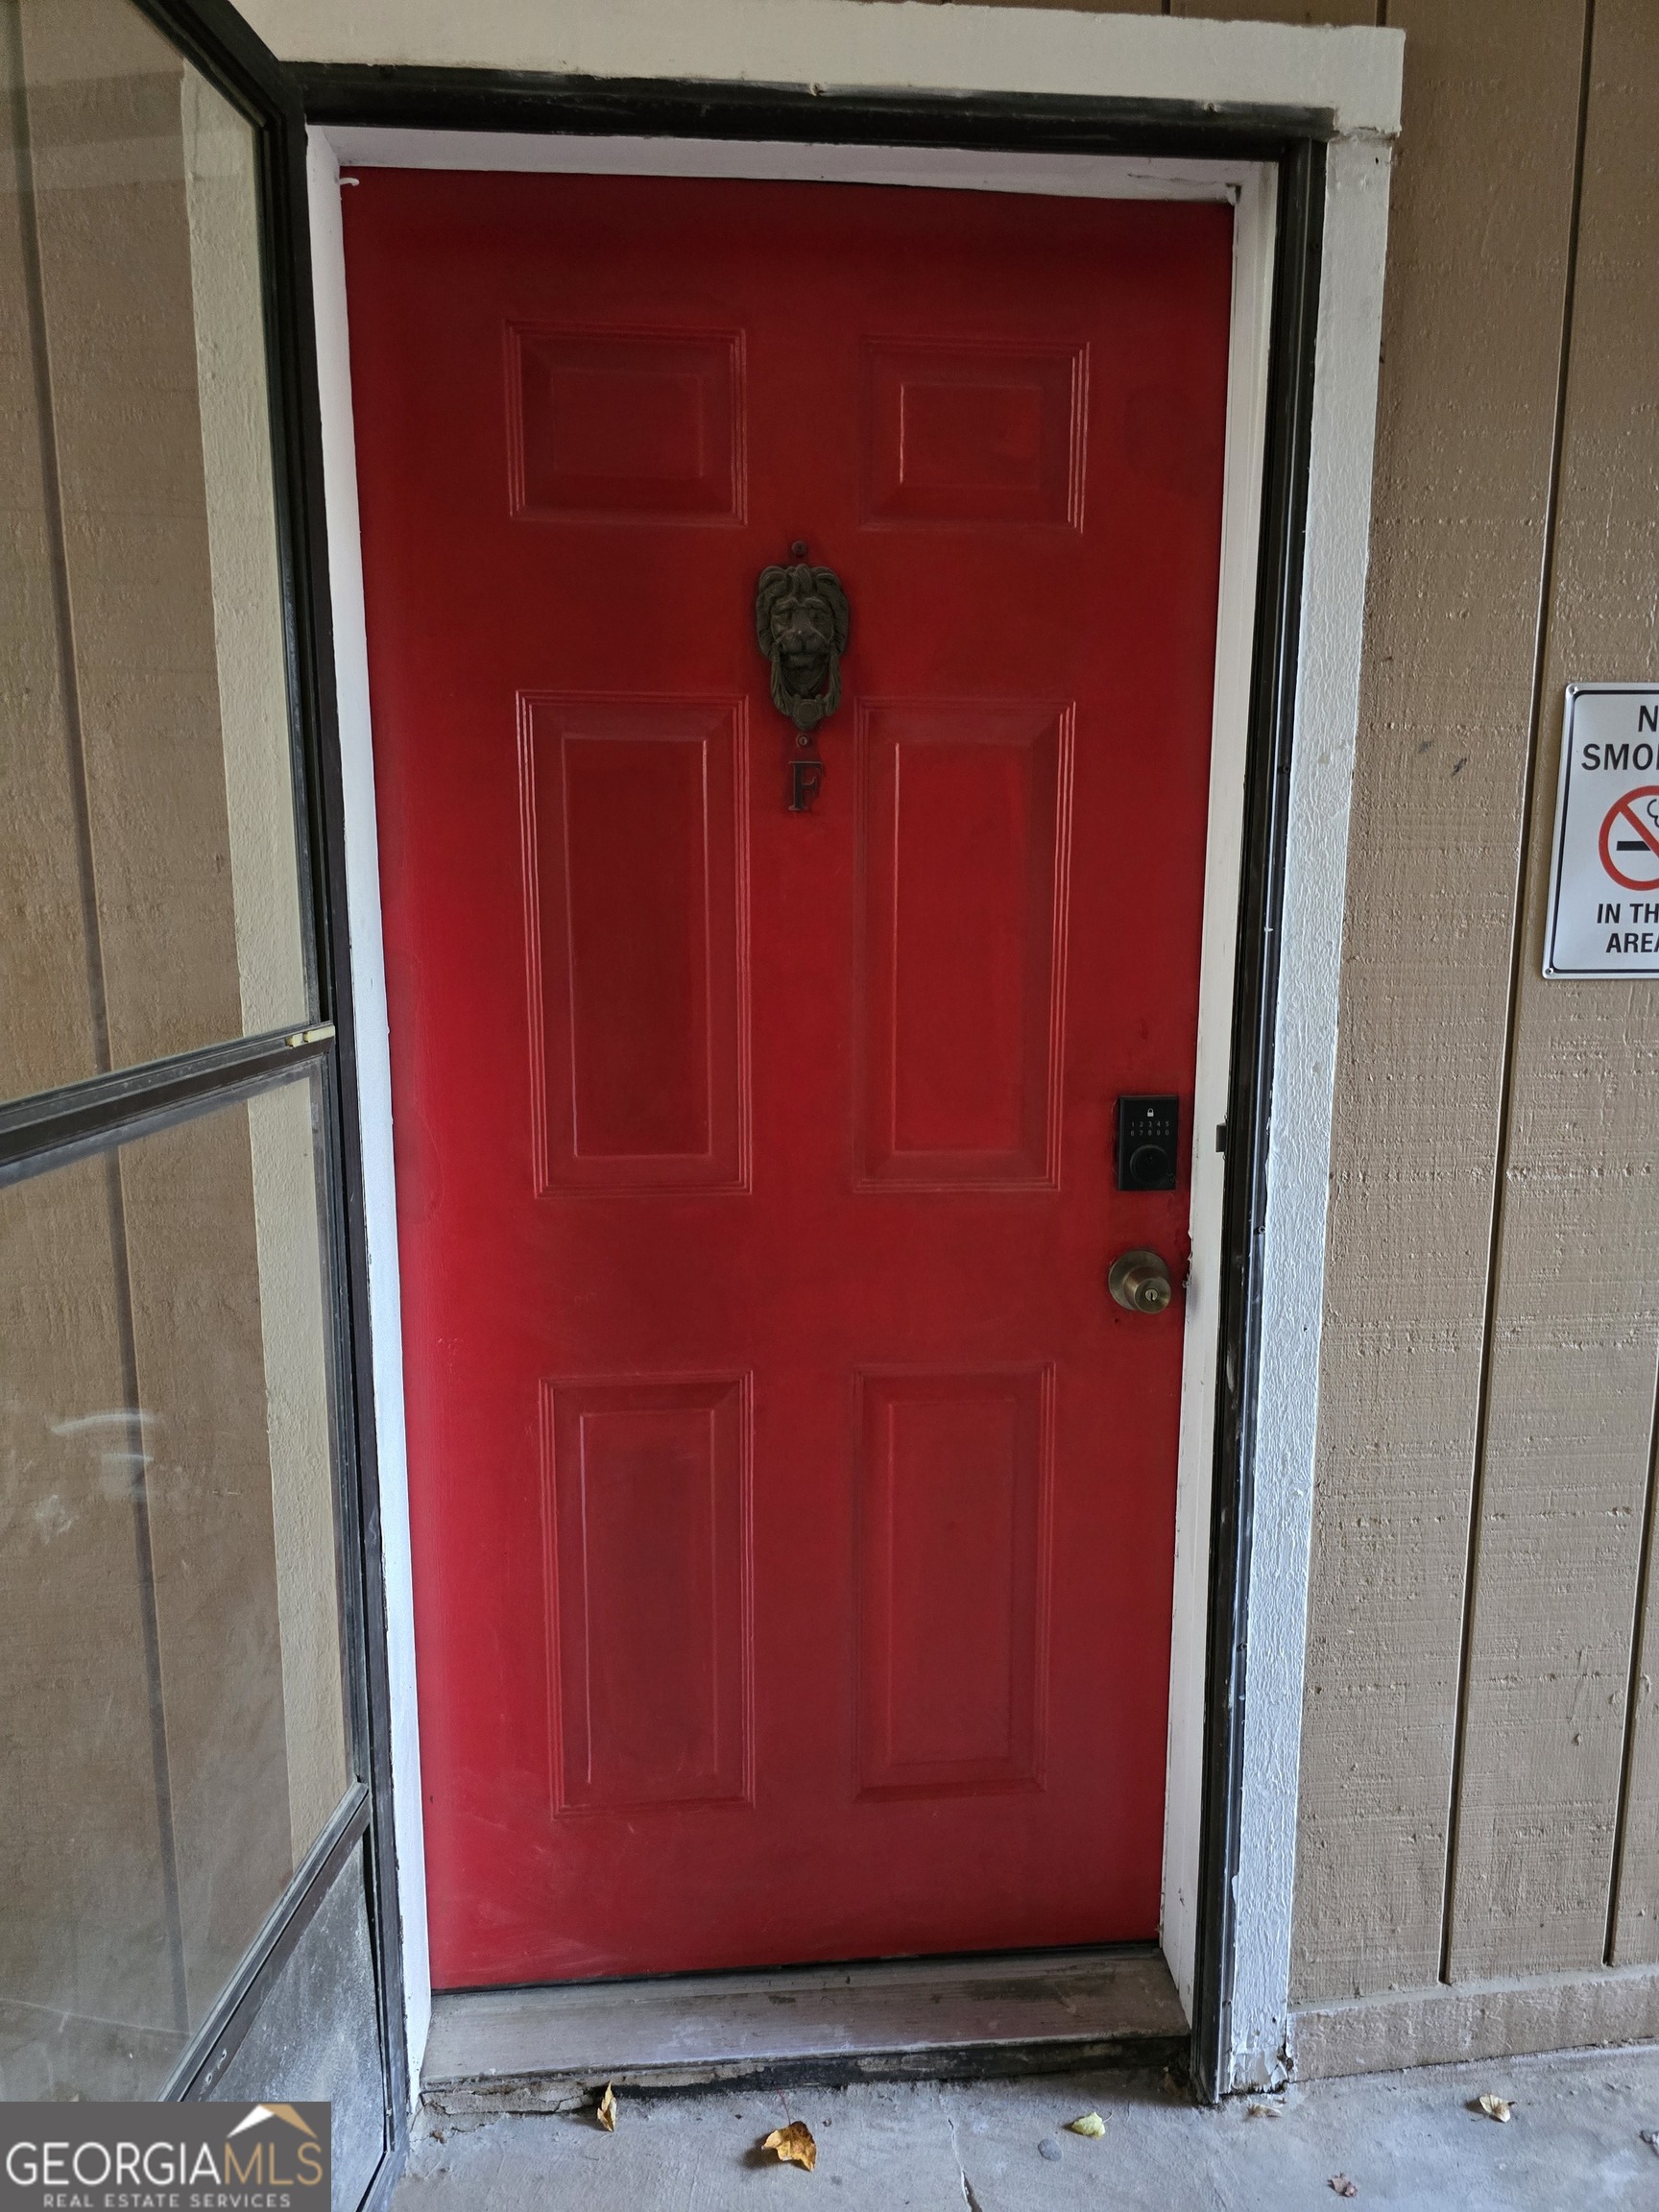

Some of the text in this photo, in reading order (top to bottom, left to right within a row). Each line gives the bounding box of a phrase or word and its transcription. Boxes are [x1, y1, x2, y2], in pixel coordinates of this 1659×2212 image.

[1581, 743, 1659, 771] SMO
[788, 761, 823, 810] F
[1597, 903, 1621, 924] IN
